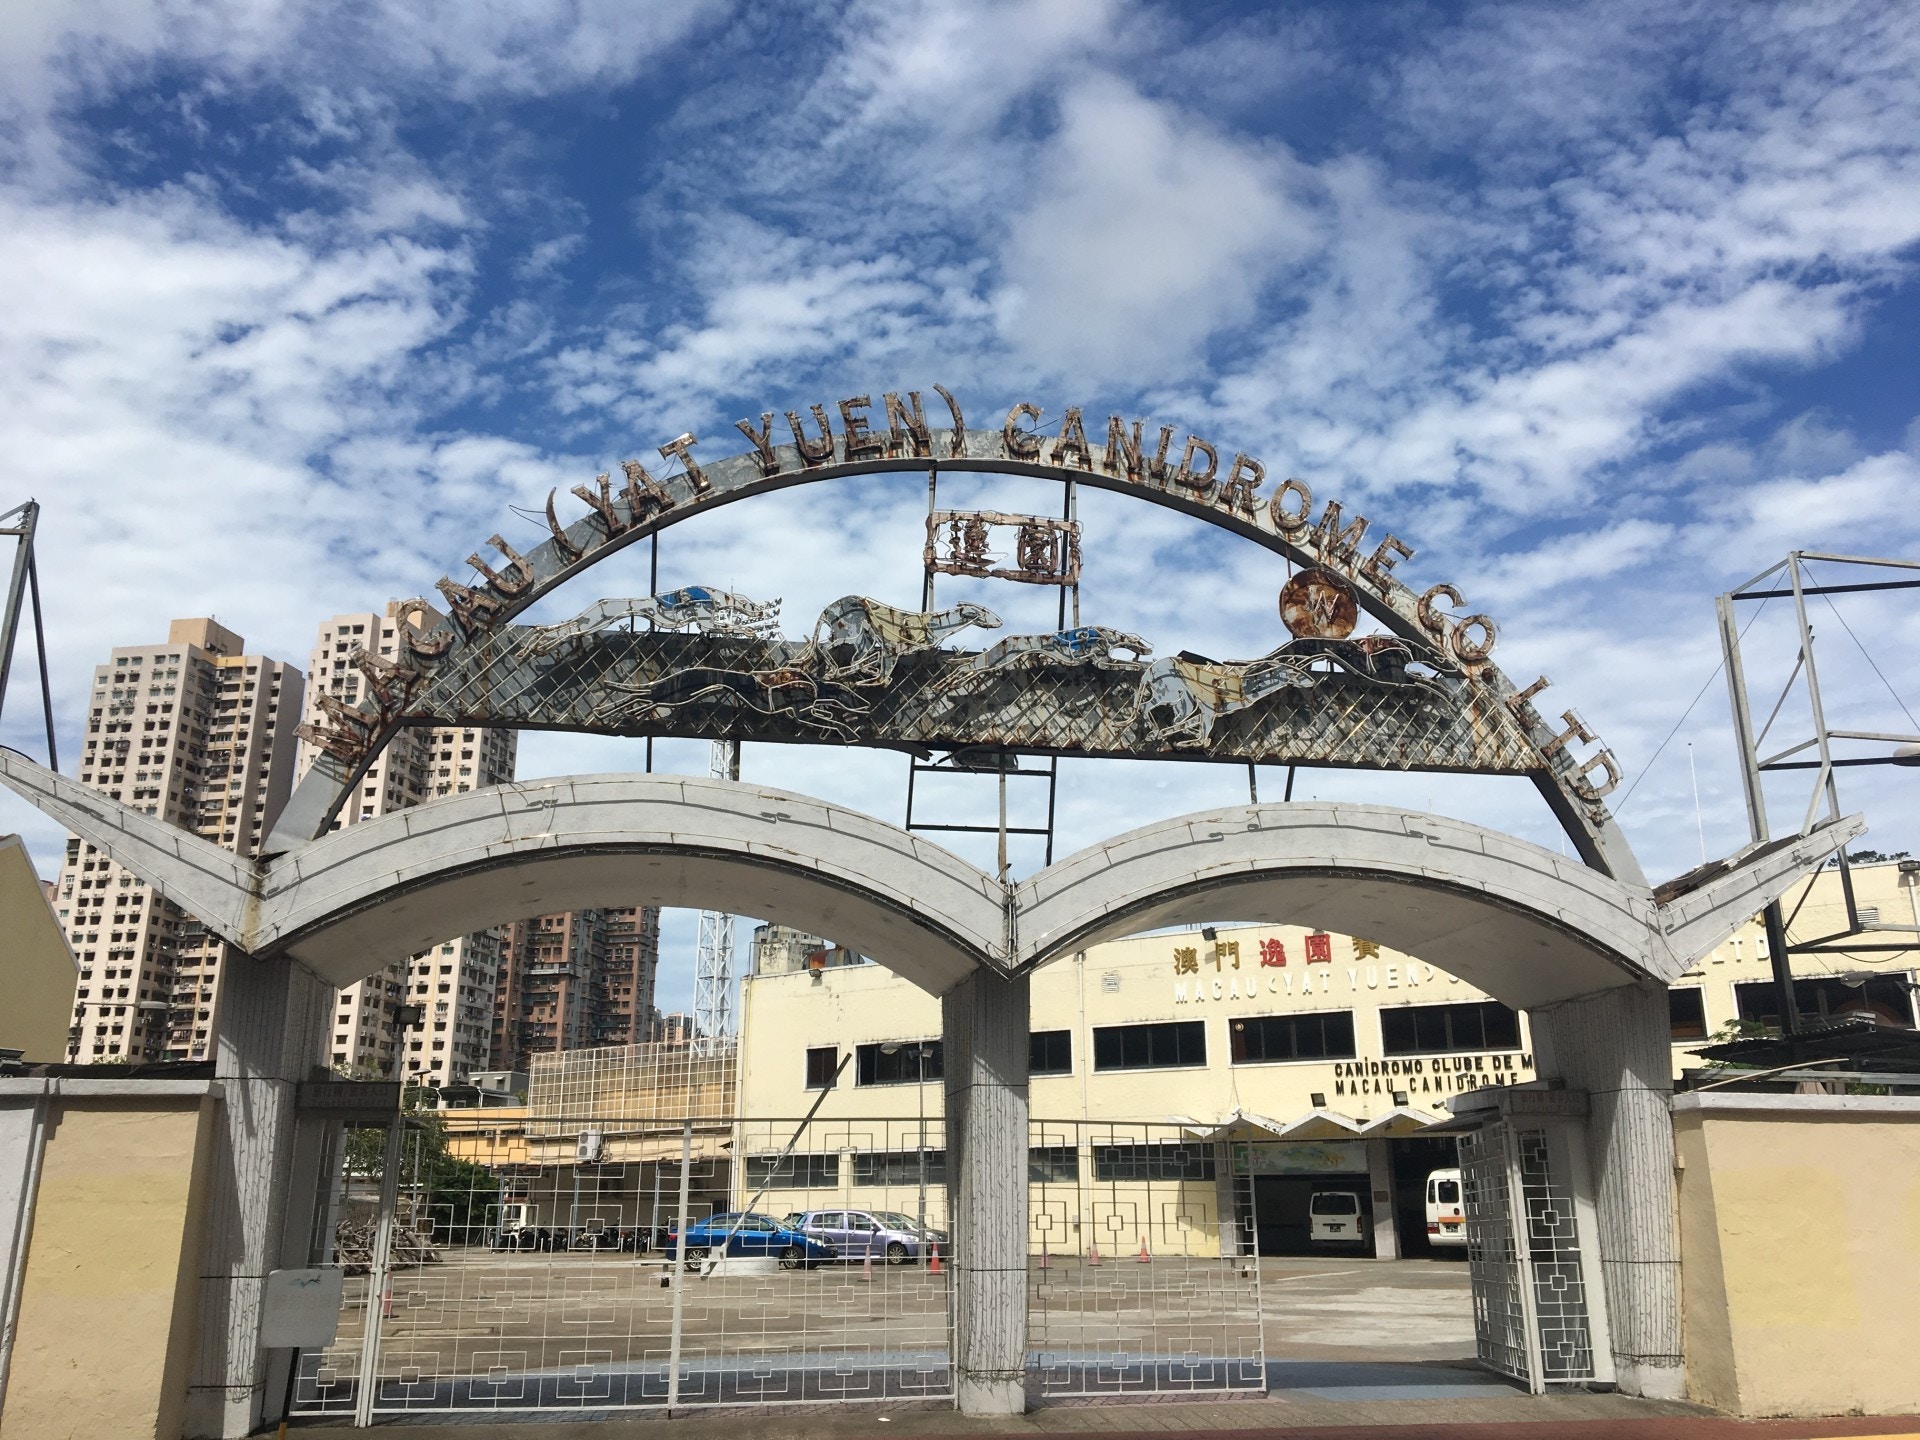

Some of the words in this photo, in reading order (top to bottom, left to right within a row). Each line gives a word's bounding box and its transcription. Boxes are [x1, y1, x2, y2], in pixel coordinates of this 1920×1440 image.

[293, 533, 535, 765] MACAU
[546, 431, 710, 562] (YAT
[735, 382, 964, 475] YUEN)
[1004, 402, 1415, 590] CANIDROME
[1174, 975, 1257, 1004] MACAU
[1268, 967, 1331, 996] (YAT
[1346, 962, 1434, 992] YUEN)
[1432, 1056, 1483, 1074] CLUBE
[1493, 1055, 1513, 1071] DE
[1336, 1077, 1394, 1096] MACAU
